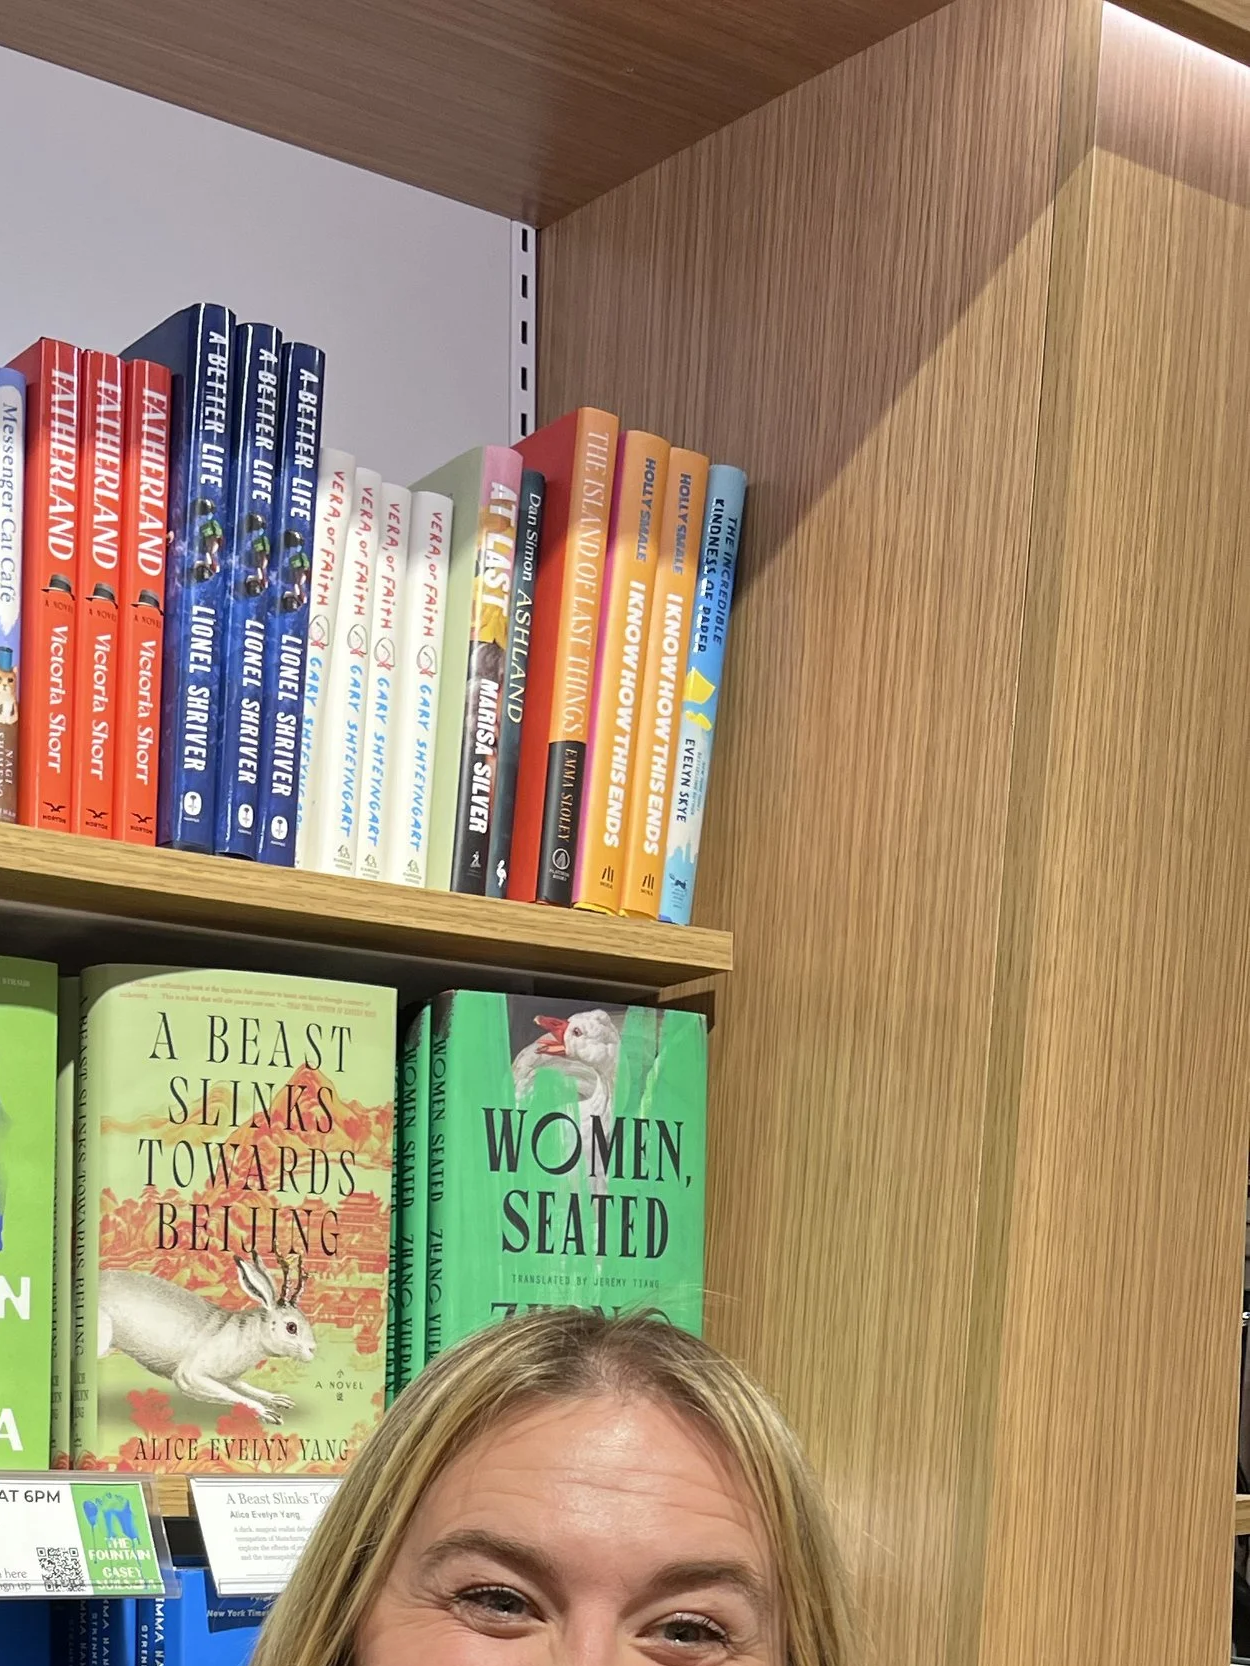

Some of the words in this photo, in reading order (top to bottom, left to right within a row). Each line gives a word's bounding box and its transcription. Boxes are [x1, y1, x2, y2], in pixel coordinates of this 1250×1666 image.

[209, 330, 222, 346] A
[204, 348, 228, 433] BETTER
[49, 368, 76, 563] FATHERLAND
[201, 440, 225, 489] LIFE
[49, 625, 68, 718] Victoria
[507, 588, 534, 725] ASHLAND
[418, 684, 432, 731] GARY
[475, 678, 498, 755] MARISA
[46, 725, 65, 774] Shorr
[683, 738, 696, 788] EVELYN
[410, 739, 428, 852] SHTEYNGART
[468, 762, 494, 836] SILVER
[676, 795, 689, 823] SKYE
[148, 1012, 178, 1061] A
[207, 1016, 353, 1074] BEAST
[168, 1076, 335, 1134] SLINKS
[138, 1137, 357, 1197] TOWARDS
[482, 1106, 693, 1190] WOMEN,
[155, 1203, 340, 1257] BEIJING
[501, 1189, 669, 1260] SEATED
[134, 1438, 199, 1462] ALICE
[208, 1437, 291, 1463] EVELYN
[298, 1438, 350, 1462] YANG
[24, 1490, 61, 1503] 6PM
